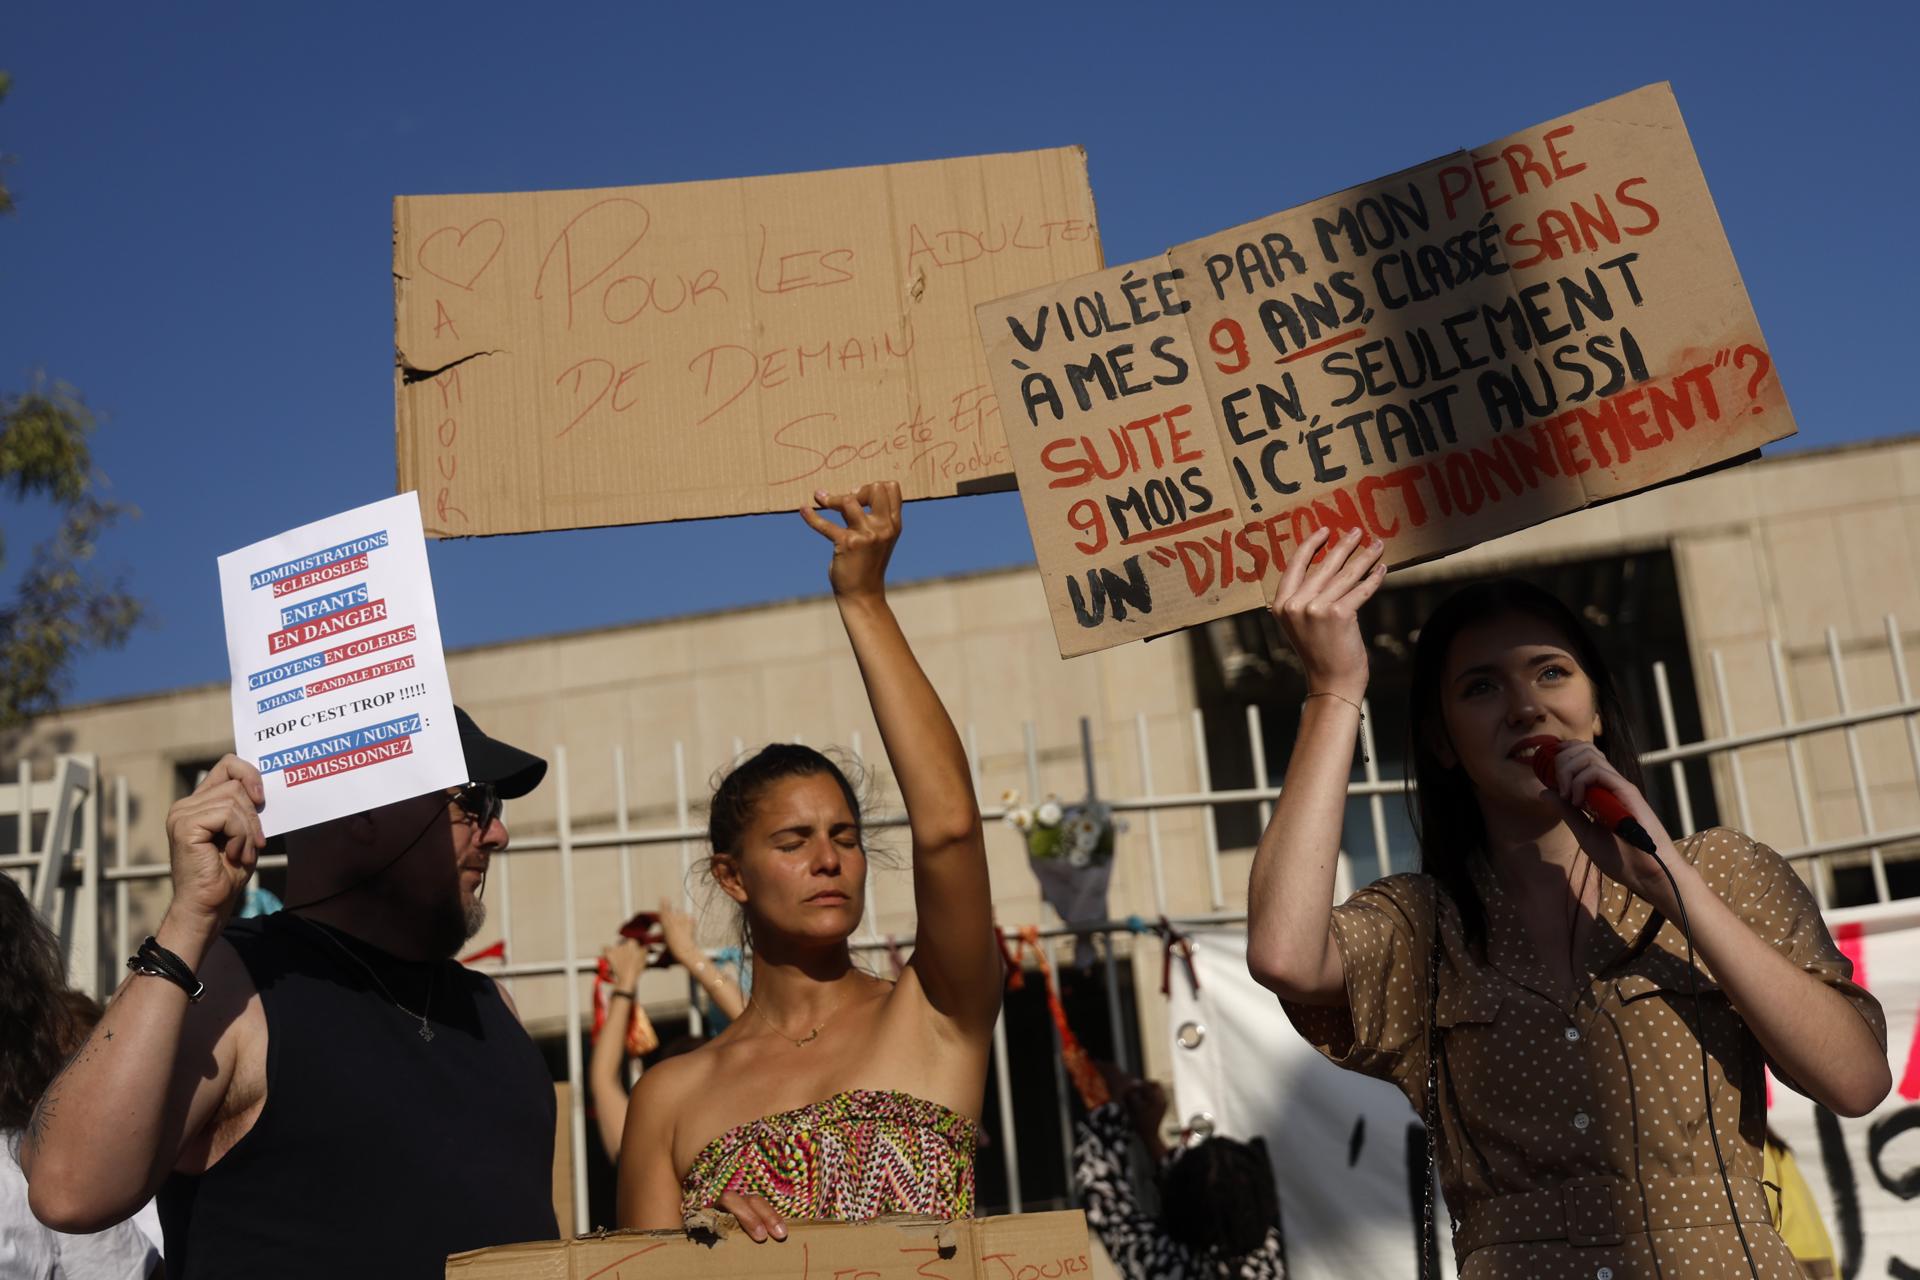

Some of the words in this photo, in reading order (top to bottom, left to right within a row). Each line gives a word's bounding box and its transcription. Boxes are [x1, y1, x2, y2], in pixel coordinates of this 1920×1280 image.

[756, 224, 855, 294] LES
[1007, 269, 1191, 352] VIOLÉE
[1205, 233, 1308, 299] PAR
[1313, 183, 1430, 262] MON
[1438, 125, 1588, 221] PÈRE
[1011, 360, 1064, 426] À
[1066, 336, 1189, 411] MES
[1209, 318, 1250, 374] 9
[1258, 272, 1374, 355] ANS,
[1372, 212, 1510, 311] CLASSÉ
[1506, 177, 1660, 269] SANS
[555, 358, 650, 439] DE
[1041, 404, 1205, 489] SUITE
[1221, 372, 1307, 445] EN
[1322, 253, 1644, 407] SEULEMENT
[769, 404, 936, 486] Société
[1067, 499, 1108, 555] 9
[1106, 467, 1213, 541] MOIS
[1234, 456, 1263, 513] !
[1261, 385, 1459, 495] C'ÉTAIT
[1476, 327, 1650, 432] AUSSI
[251, 533, 388, 588] ADMINISTRATIONS
[273, 556, 368, 597] SCLEROSEES
[282, 587, 368, 626] ENFANTS
[1067, 555, 1152, 628] UN
[273, 630, 299, 651] EN
[304, 603, 386, 641] DANGER
[249, 655, 321, 689] CITOYENS
[324, 649, 344, 664] EN
[347, 628, 416, 657] COLERES
[258, 689, 304, 713] LYHANA
[306, 671, 370, 696] SCANDALE
[372, 658, 415, 677] D'ETAT
[255, 719, 297, 742] TROP
[300, 704, 347, 728] C'EST
[350, 691, 395, 714] TROP
[260, 736, 352, 772] DARMANIN
[363, 717, 421, 744] NUNEZ
[285, 739, 413, 785] DEMISSIONNEZ
